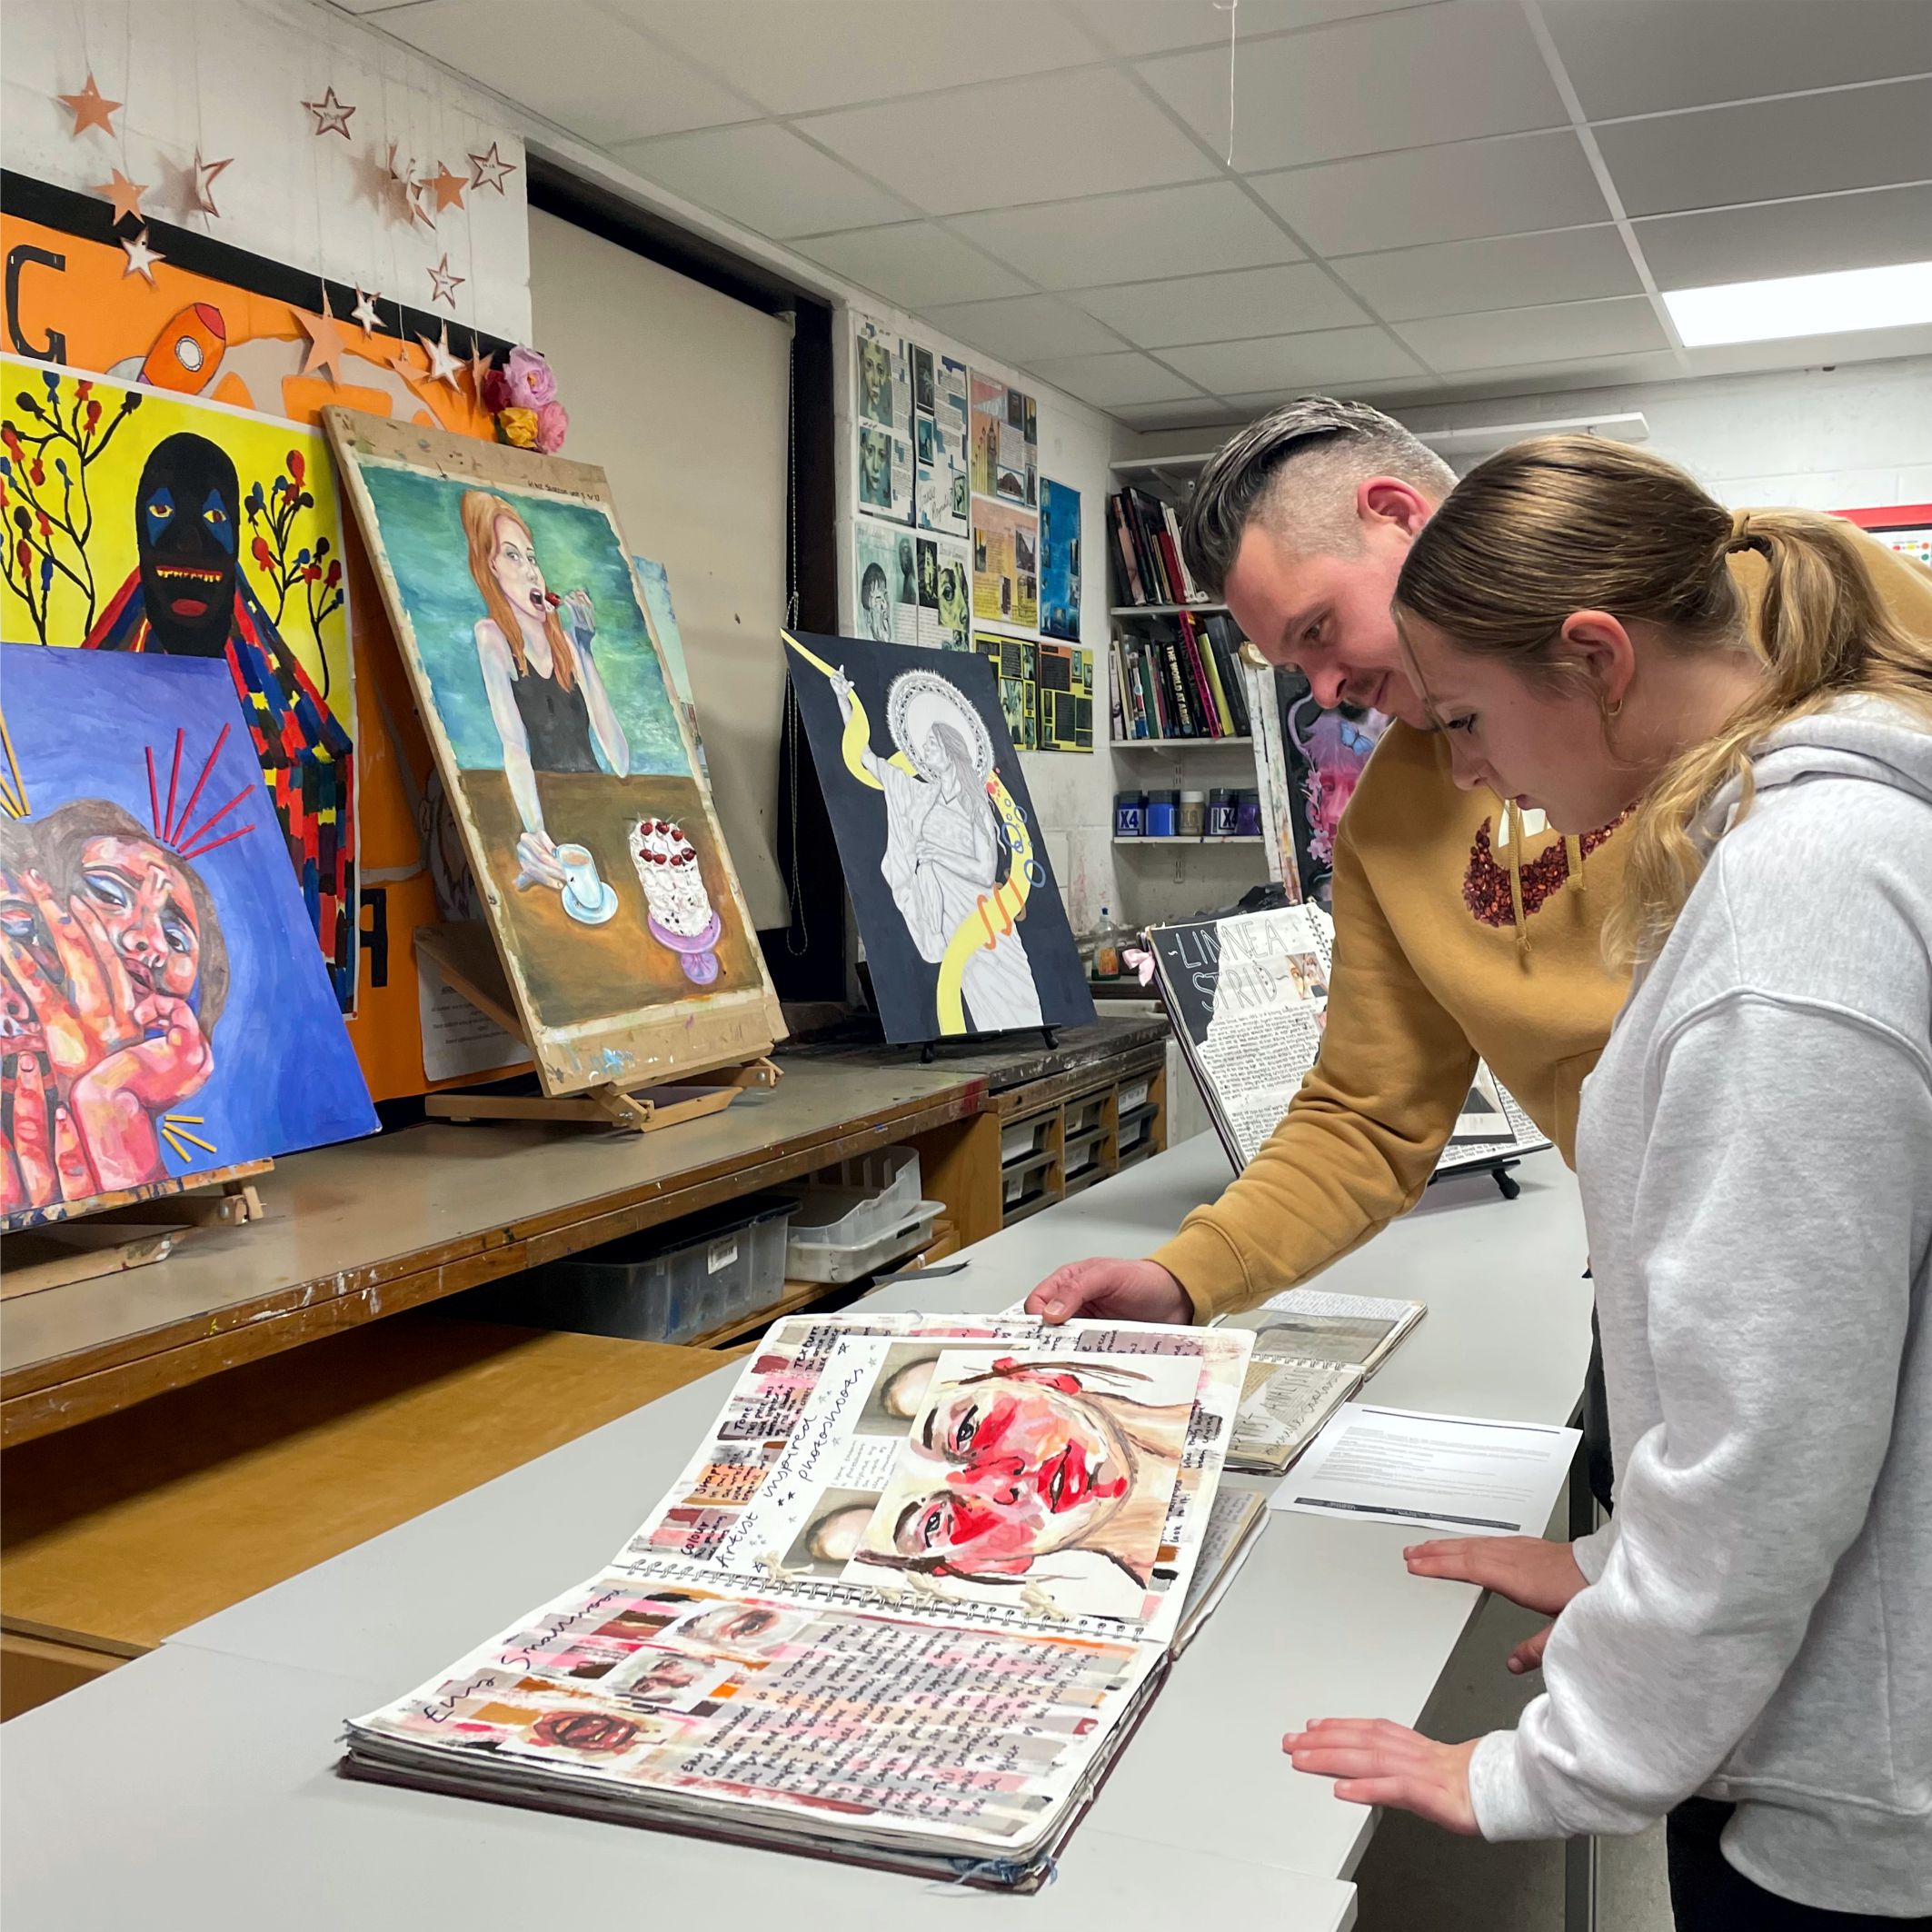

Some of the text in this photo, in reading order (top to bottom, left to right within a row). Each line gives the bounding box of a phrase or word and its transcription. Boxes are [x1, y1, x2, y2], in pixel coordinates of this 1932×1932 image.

[5, 244, 67, 365] G
[1166, 644, 1178, 662] THE
[1170, 662, 1183, 692] WORLD
[1120, 810, 1139, 829] X4
[1175, 918, 1289, 970] LINNEA
[1191, 964, 1278, 1012] STRID
[793, 1326, 820, 1369] Texture
[733, 1407, 752, 1430] Tone
[798, 1369, 863, 1481] photoshoots
[694, 1462, 722, 1494] Shape
[715, 1411, 817, 1569] Artist inspired
[680, 1521, 709, 1556] Colour
